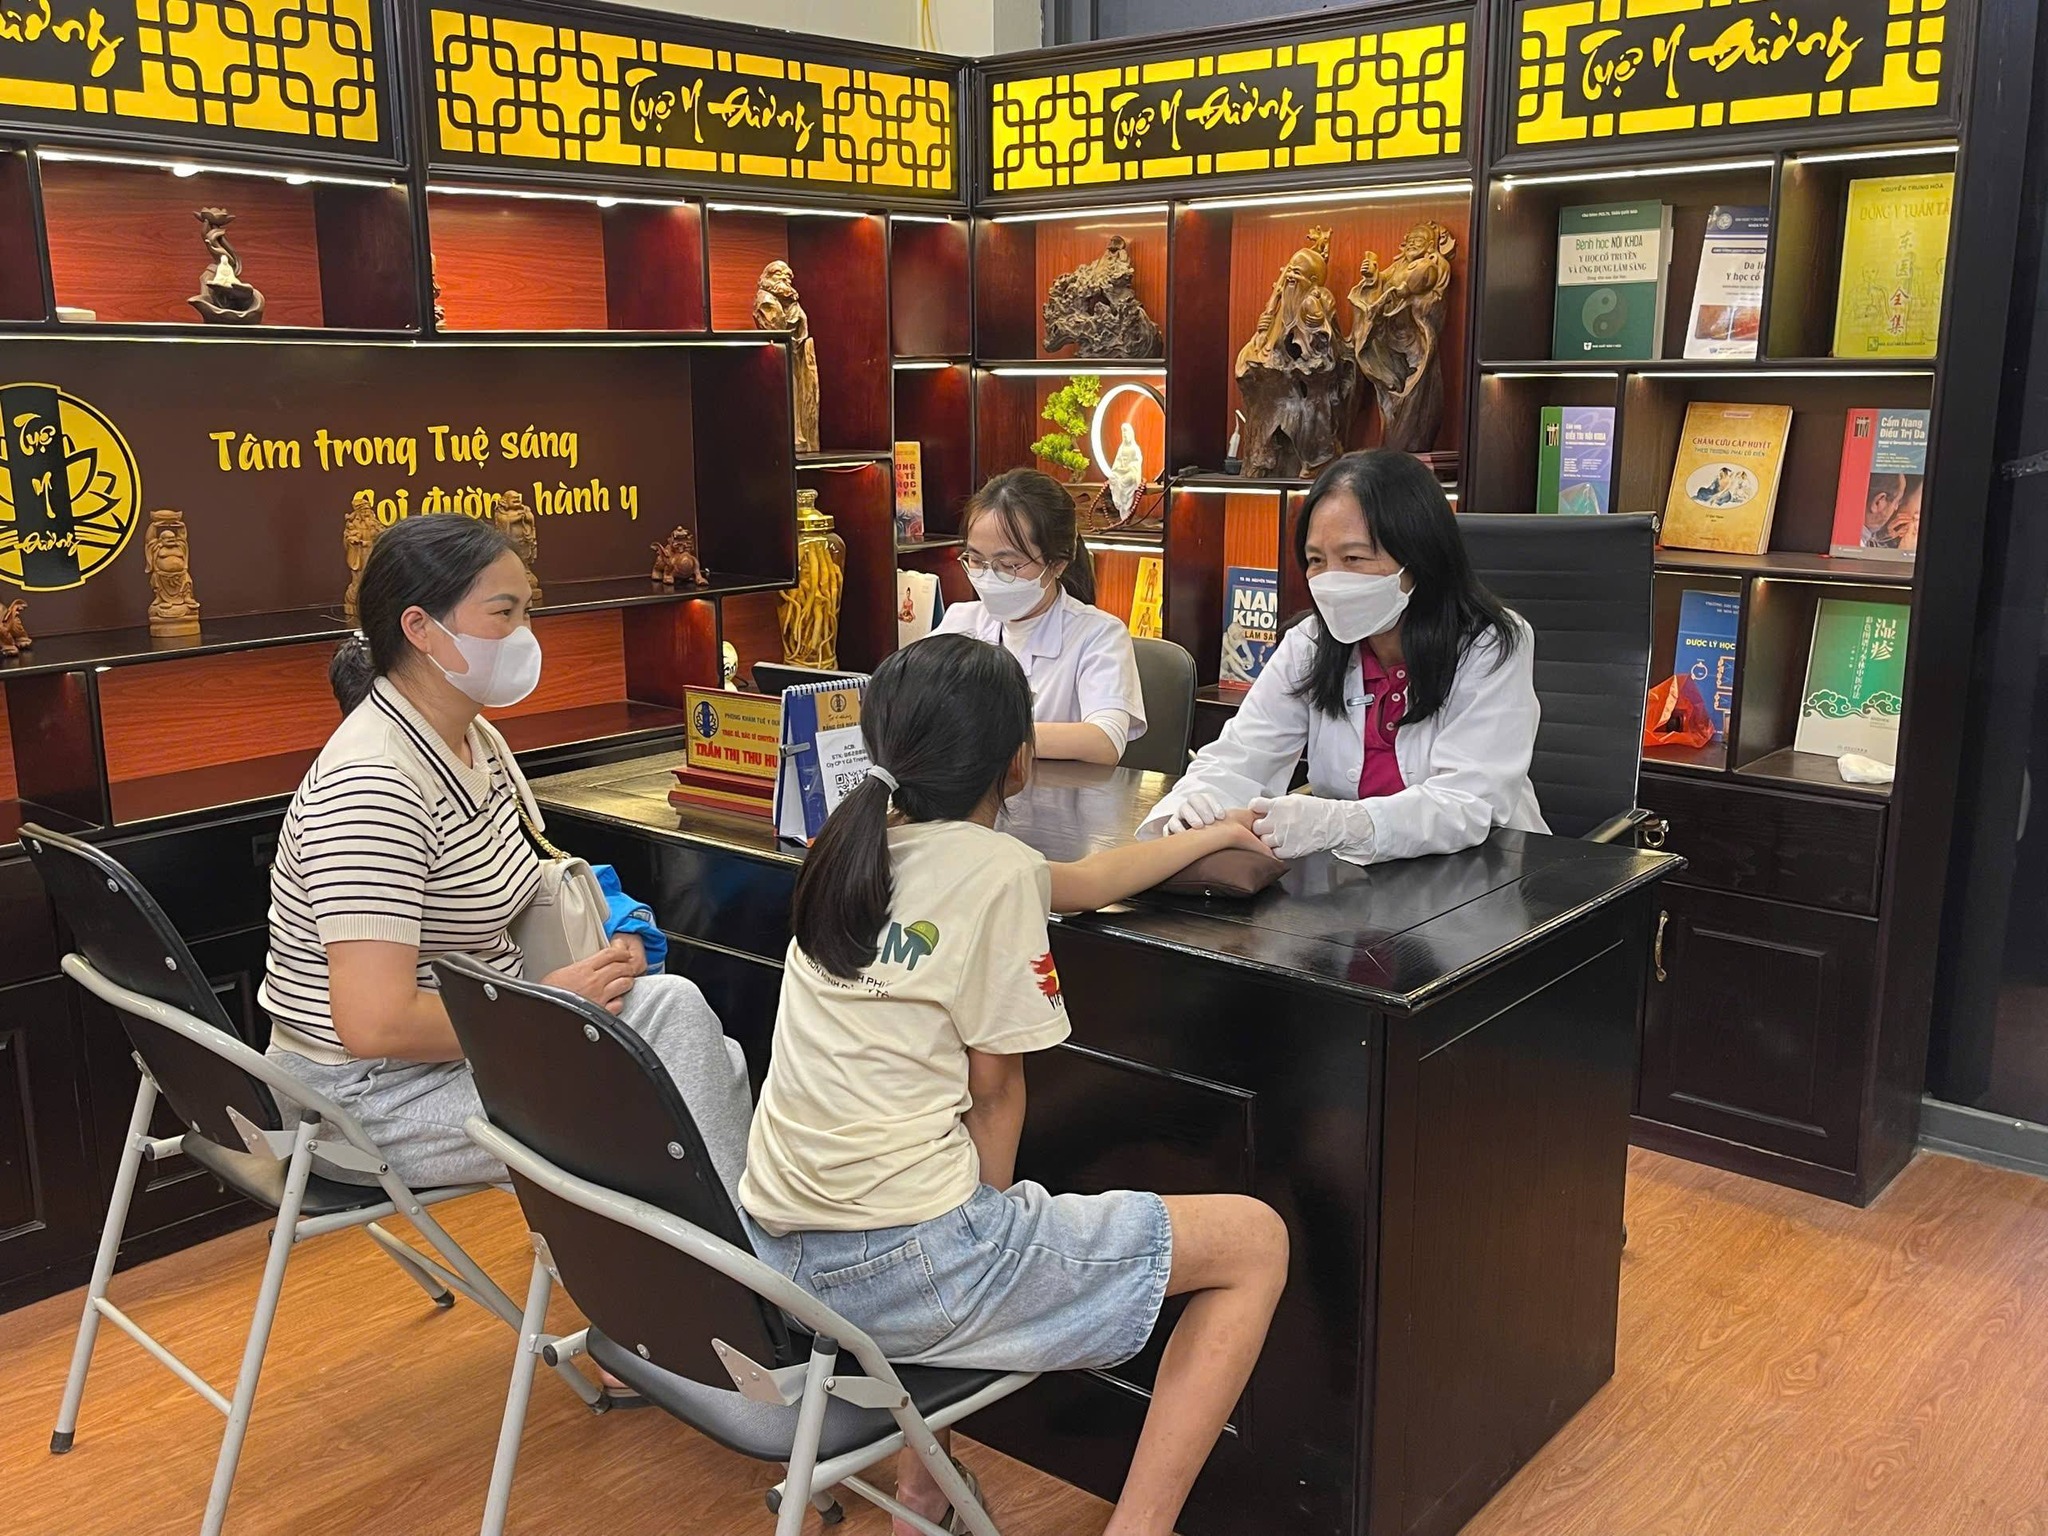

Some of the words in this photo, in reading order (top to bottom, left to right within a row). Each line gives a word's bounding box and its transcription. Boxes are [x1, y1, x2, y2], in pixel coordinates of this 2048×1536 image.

[1580, 29, 1643, 100] Tuệ
[1689, 12, 1863, 82] Đường
[625, 67, 675, 133] Tuệ
[708, 86, 814, 152] Đường
[1110, 92, 1155, 150] Tuệ
[1186, 81, 1304, 141] Đường
[1624, 234, 1643, 247] KHOA
[1733, 272, 1748, 282] học
[13, 413, 56, 456] Tuệ
[1901, 418, 1923, 429] Nang
[209, 431, 300, 471] Tâm
[313, 429, 416, 476] trong
[427, 425, 489, 469] Tuệ
[501, 424, 578, 468] sáng
[421, 486, 502, 519] đườn
[533, 478, 609, 516] hành
[621, 485, 638, 520] y
[723, 747, 740, 764] THỊ
[742, 750, 762, 766] THU
